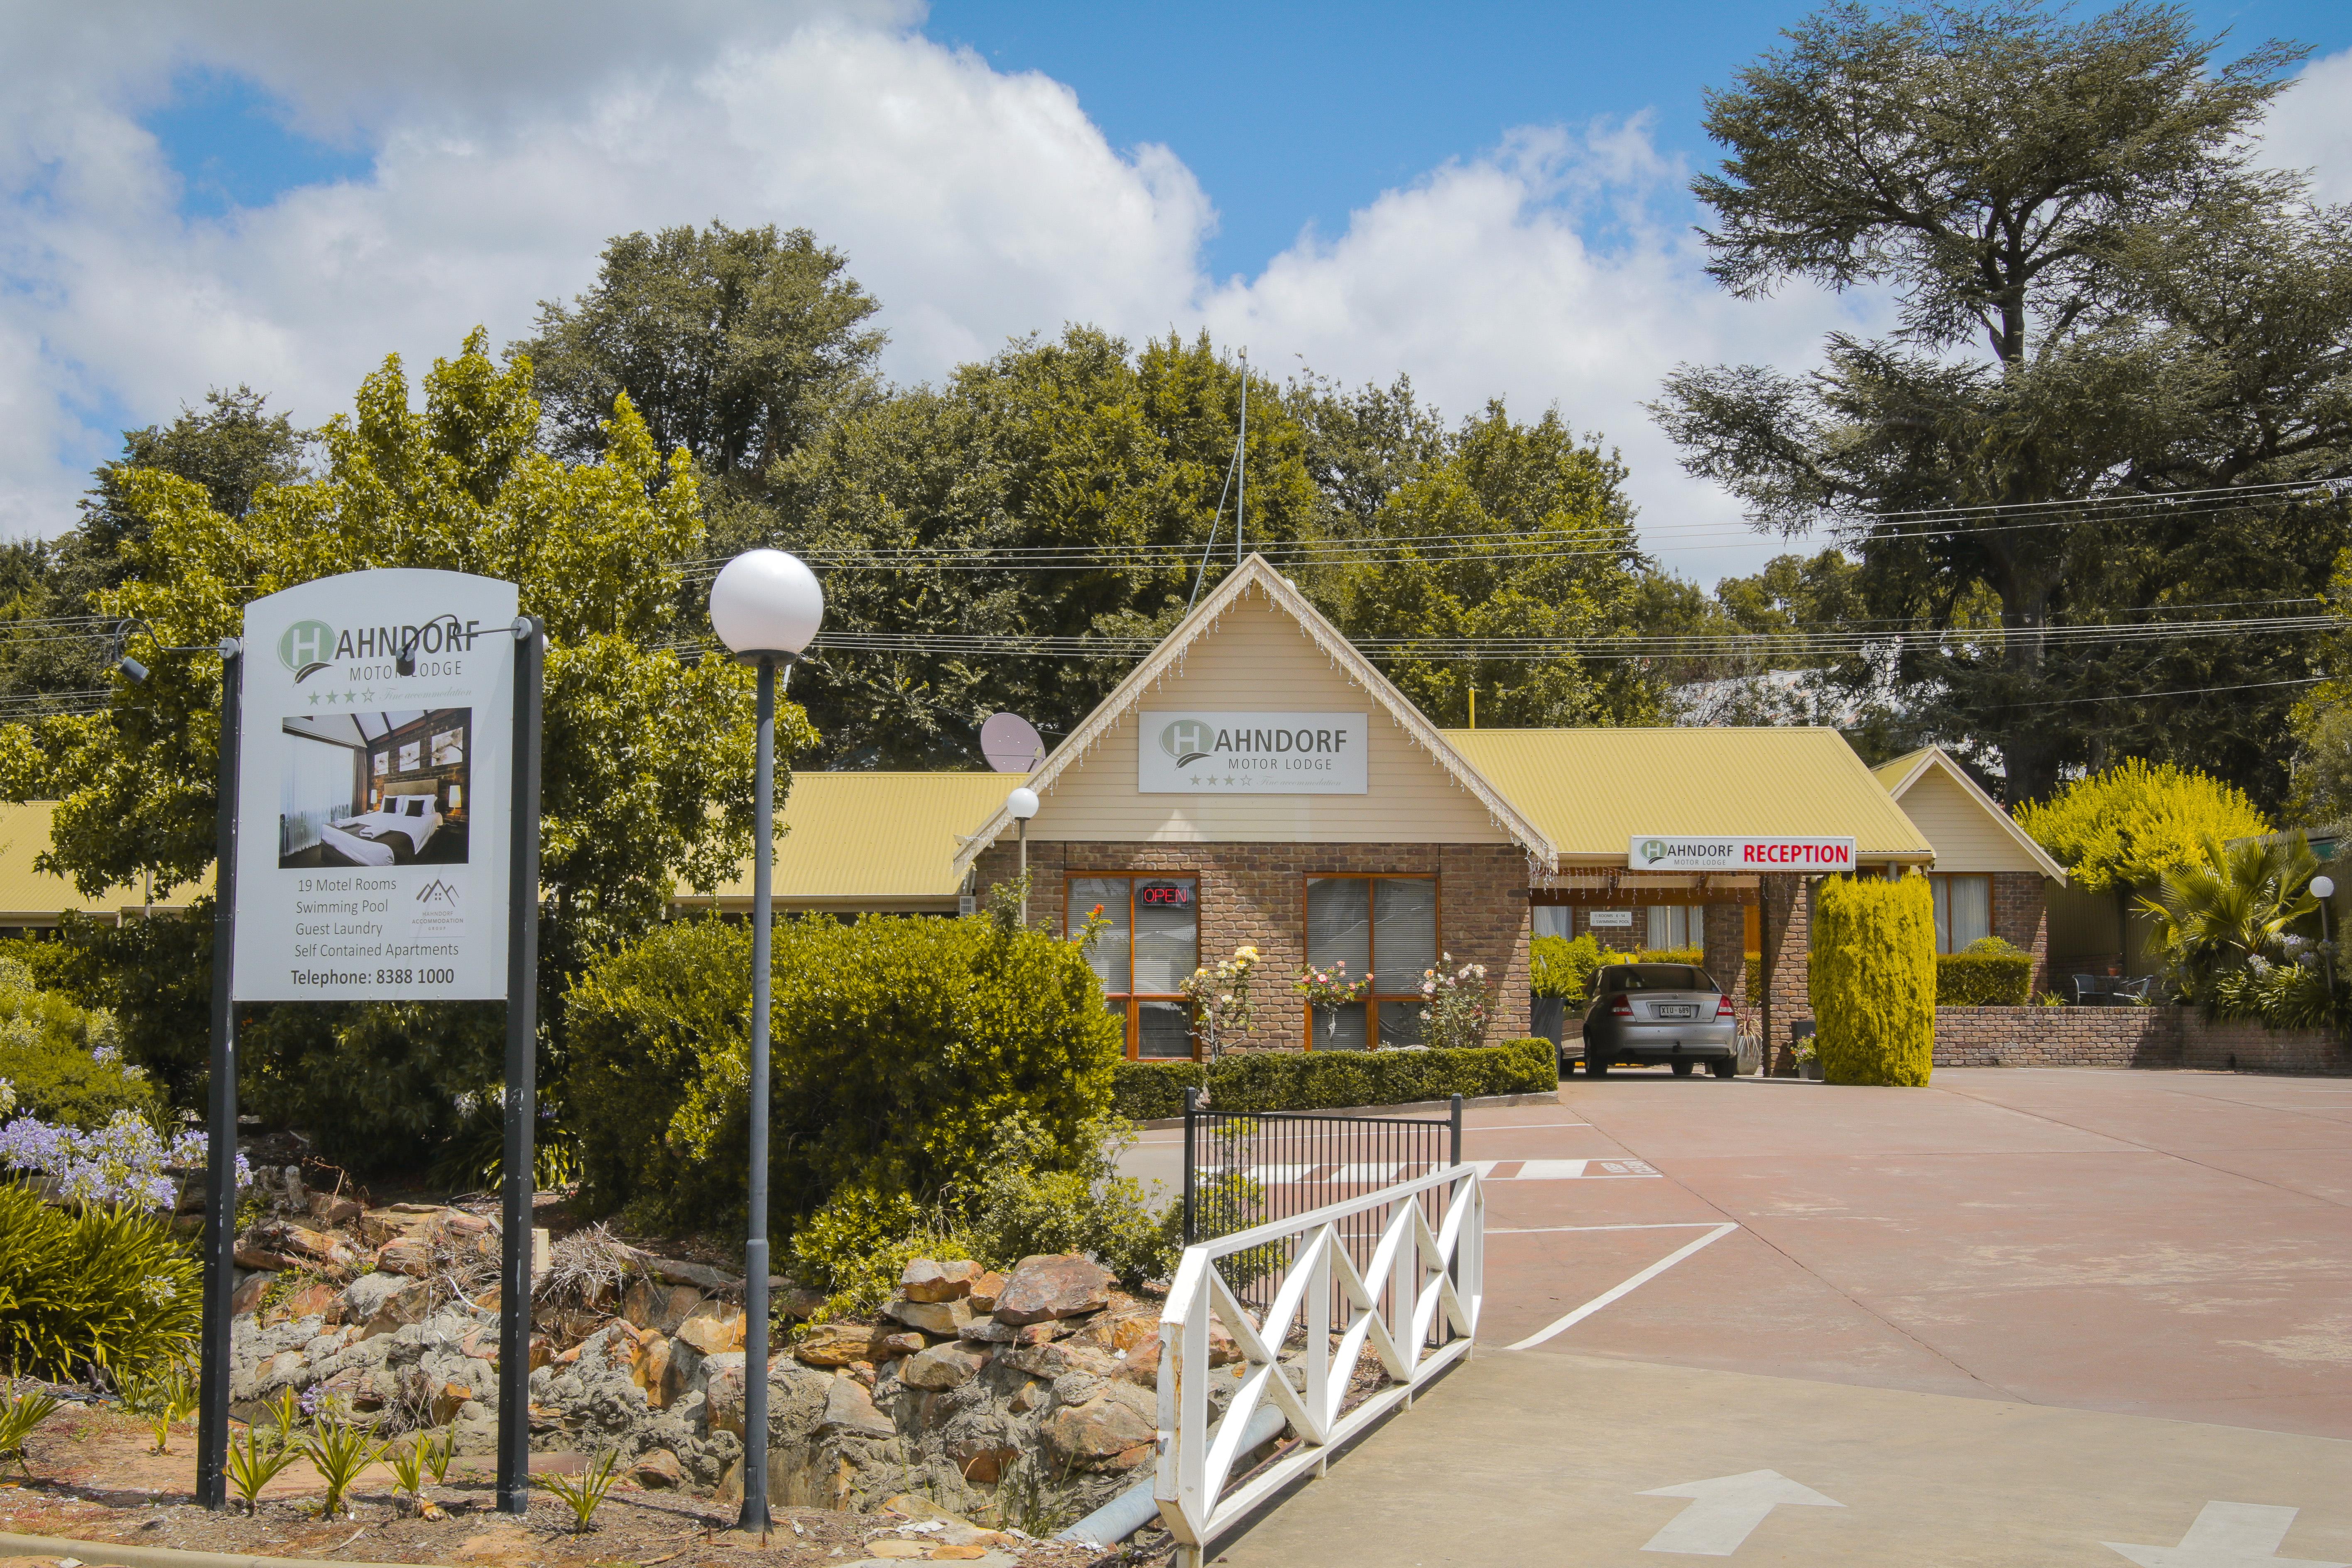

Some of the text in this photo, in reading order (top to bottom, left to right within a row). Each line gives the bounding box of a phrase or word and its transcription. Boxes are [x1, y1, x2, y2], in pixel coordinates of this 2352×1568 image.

[379, 687, 472, 701] Fine accommodation
[1173, 725, 1347, 755] HAHNDORF
[1228, 758, 1331, 770] MOTOR LODGE
[1256, 775, 1341, 786] Fine accommodation
[1647, 843, 1848, 863] HAHNDORF RECEPTION
[298, 878, 397, 892] 19 Motel Rooms
[1144, 888, 1187, 902] OPEN
[296, 899, 388, 915] Swimming Pool
[296, 921, 383, 936] Guest Laundry
[295, 943, 458, 958] Self Contained Apartments
[291, 969, 454, 987] Telephone: 8388 1000
